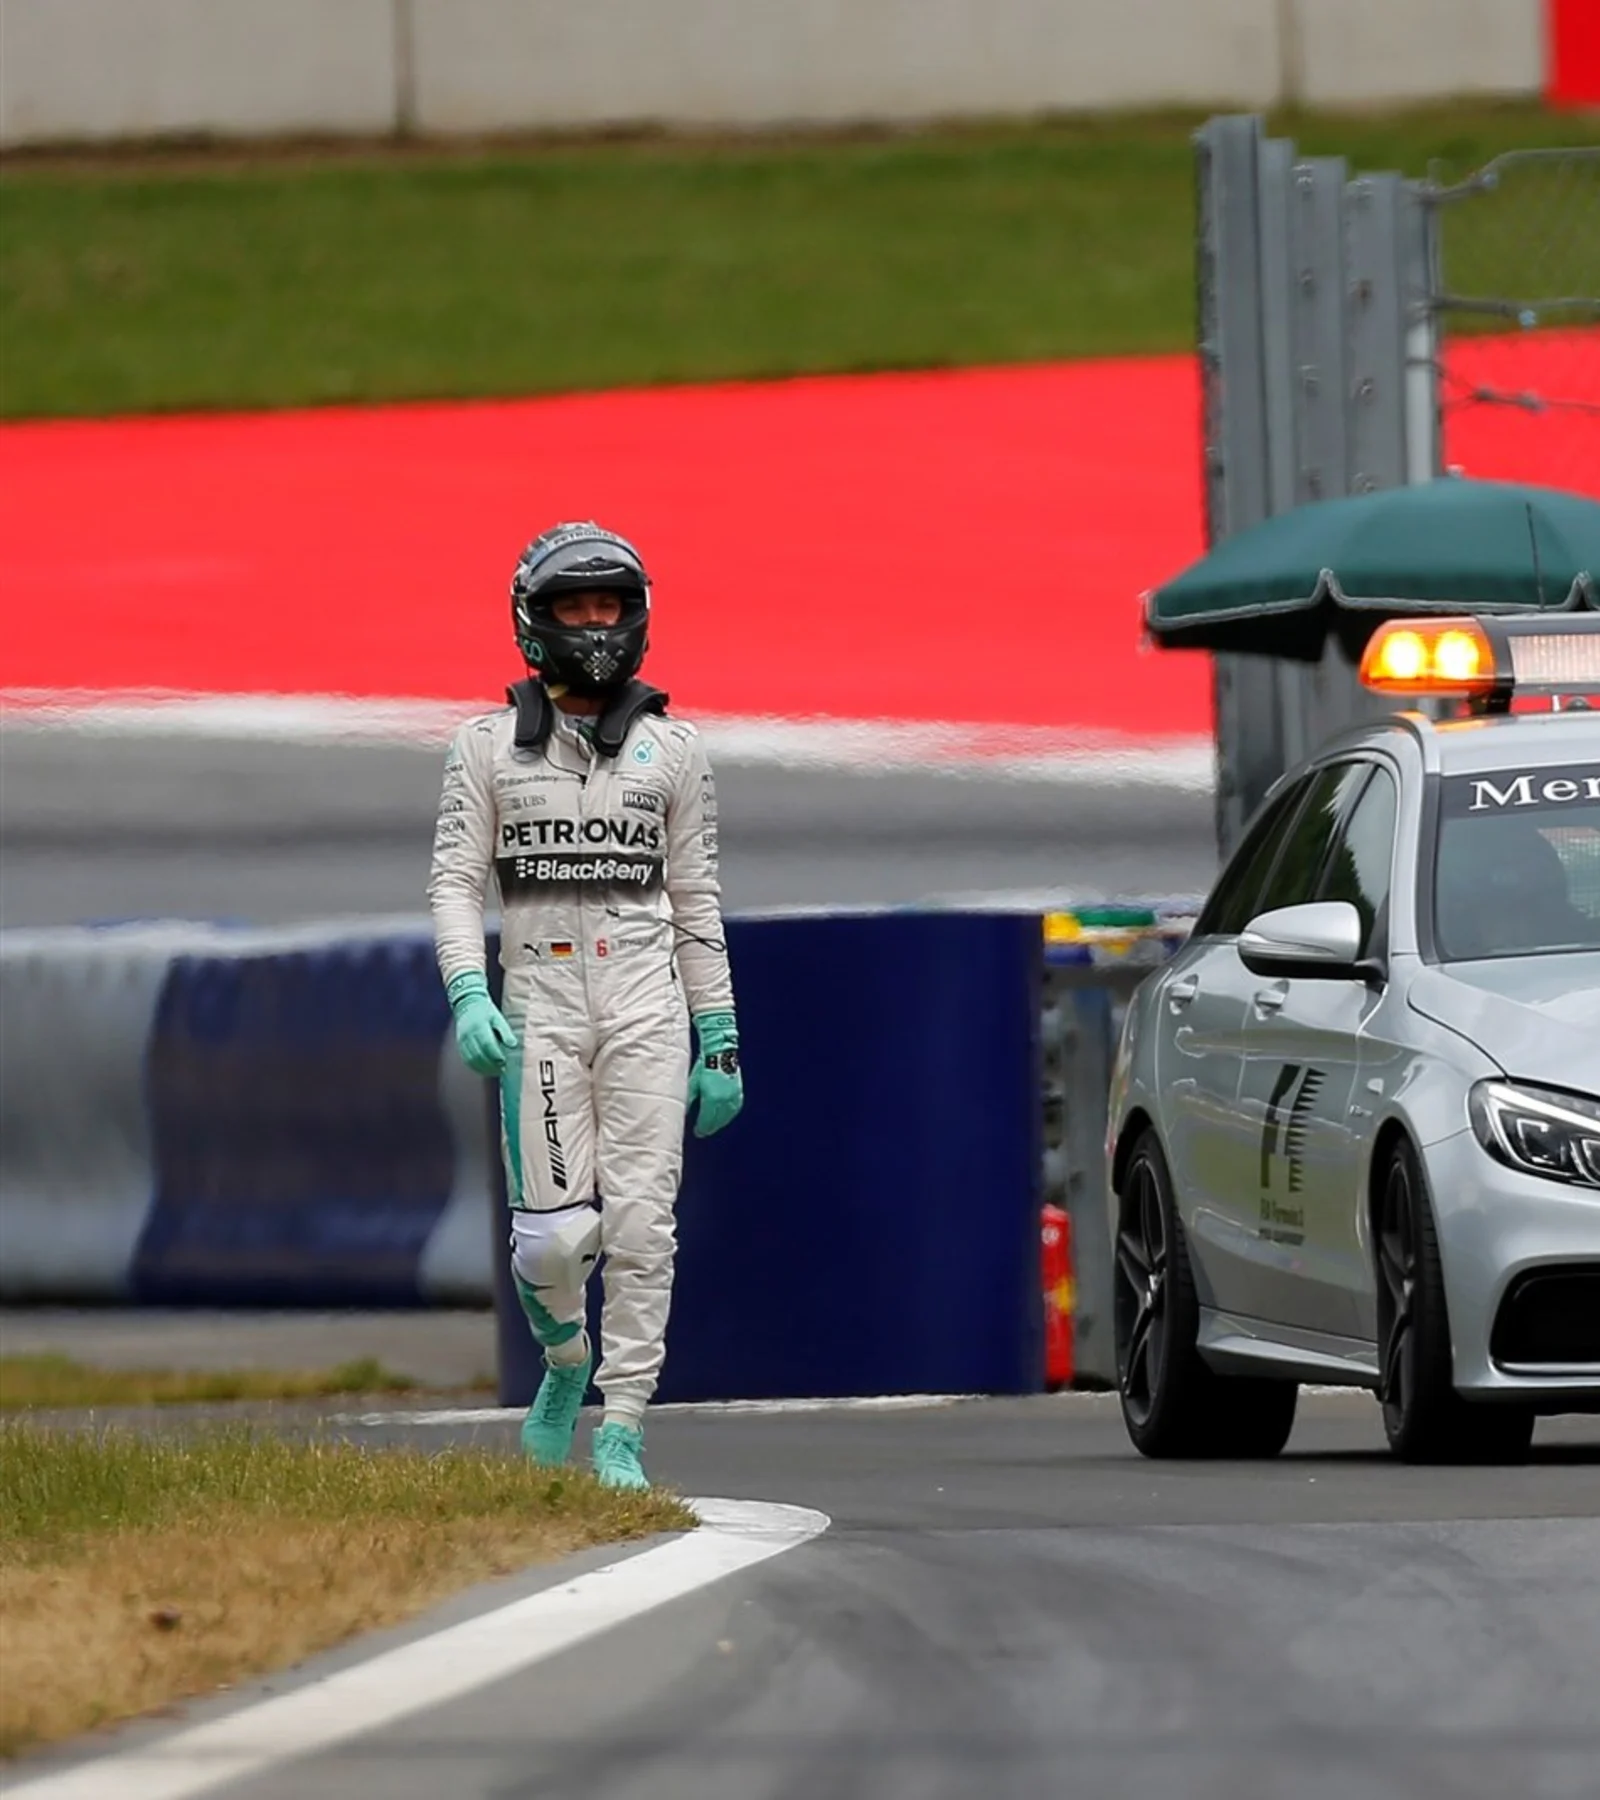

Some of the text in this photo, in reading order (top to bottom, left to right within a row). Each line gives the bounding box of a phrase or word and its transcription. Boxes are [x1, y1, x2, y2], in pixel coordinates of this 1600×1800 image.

[523, 794, 547, 807] UBS
[502, 818, 659, 849] PETRONAS
[536, 859, 653, 885] BlackBerry
[596, 938, 607, 957] 6
